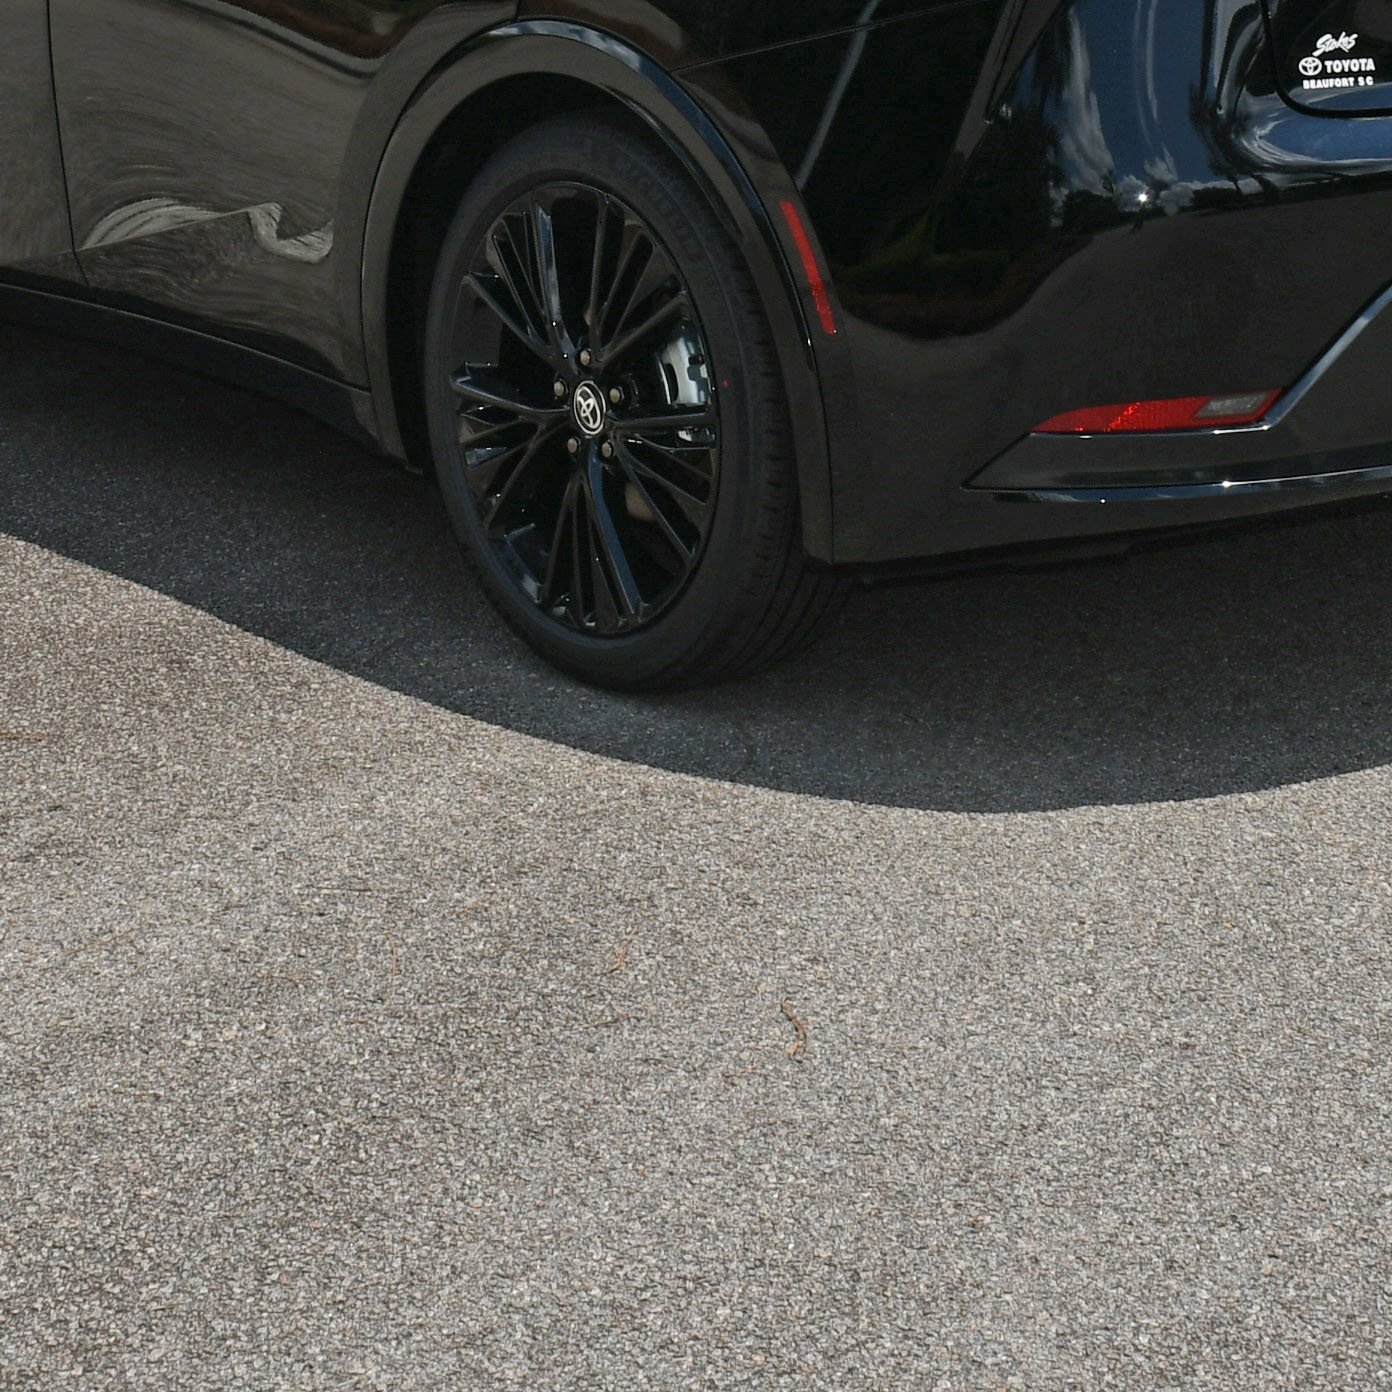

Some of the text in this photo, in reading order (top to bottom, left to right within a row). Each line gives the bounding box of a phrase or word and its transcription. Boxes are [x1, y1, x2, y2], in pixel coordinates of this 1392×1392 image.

[1312, 31, 1358, 57] Stokes
[1324, 58, 1376, 74] TOYOTA
[1302, 77, 1355, 90] BEAUFORT
